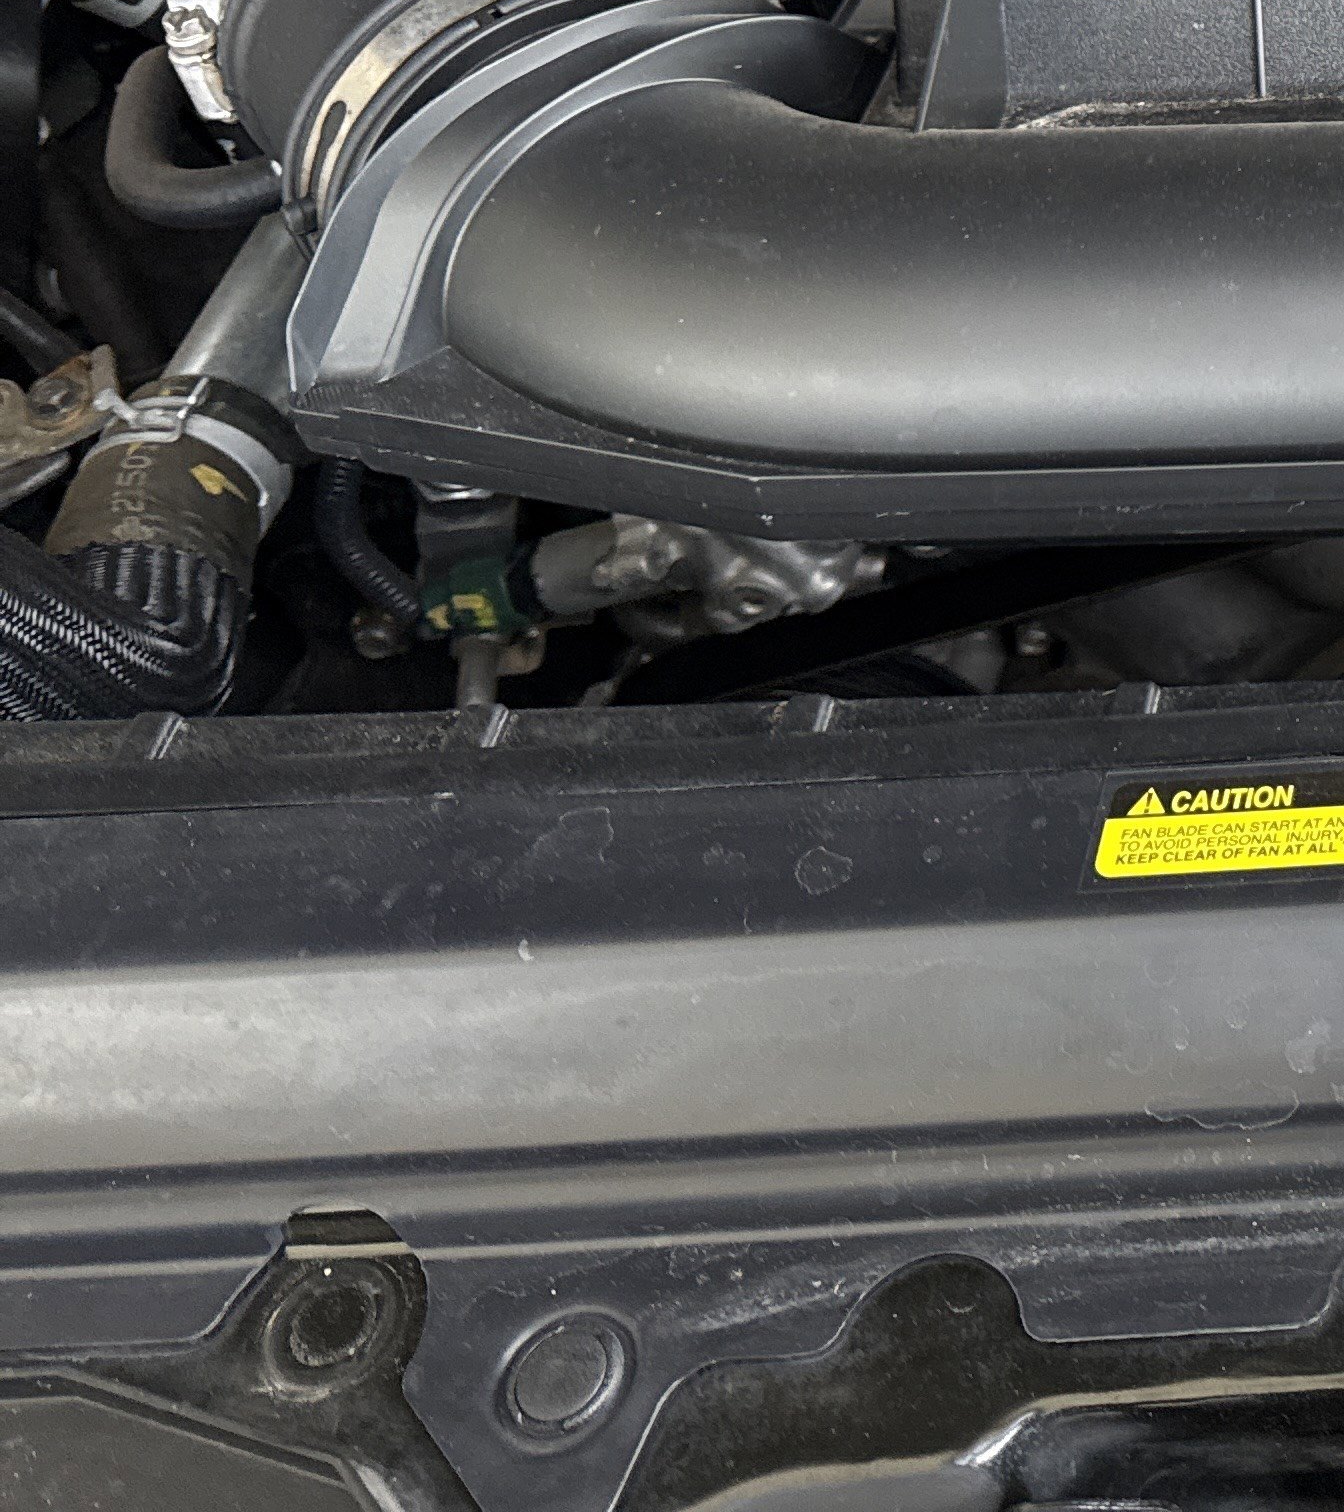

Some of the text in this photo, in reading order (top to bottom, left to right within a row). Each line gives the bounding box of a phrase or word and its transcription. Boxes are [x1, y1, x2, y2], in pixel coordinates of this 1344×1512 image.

[1171, 784, 1295, 813] CAUTION
[1120, 828, 1153, 840] FAN
[1156, 824, 1208, 839] BLADE
[1212, 822, 1246, 835] CAN
[1250, 819, 1302, 833] START
[1302, 818, 1323, 830] AT
[1115, 852, 1159, 866] KEEP
[1162, 849, 1217, 863] CLEAR
[1221, 848, 1244, 860] OF
[1247, 845, 1280, 858] FAN
[1282, 843, 1304, 856] AT
[1306, 841, 1338, 855] ALL
[1119, 841, 1141, 852] TO
[1143, 838, 1192, 851] AVOID
[1196, 833, 1282, 848] PERSONAL
